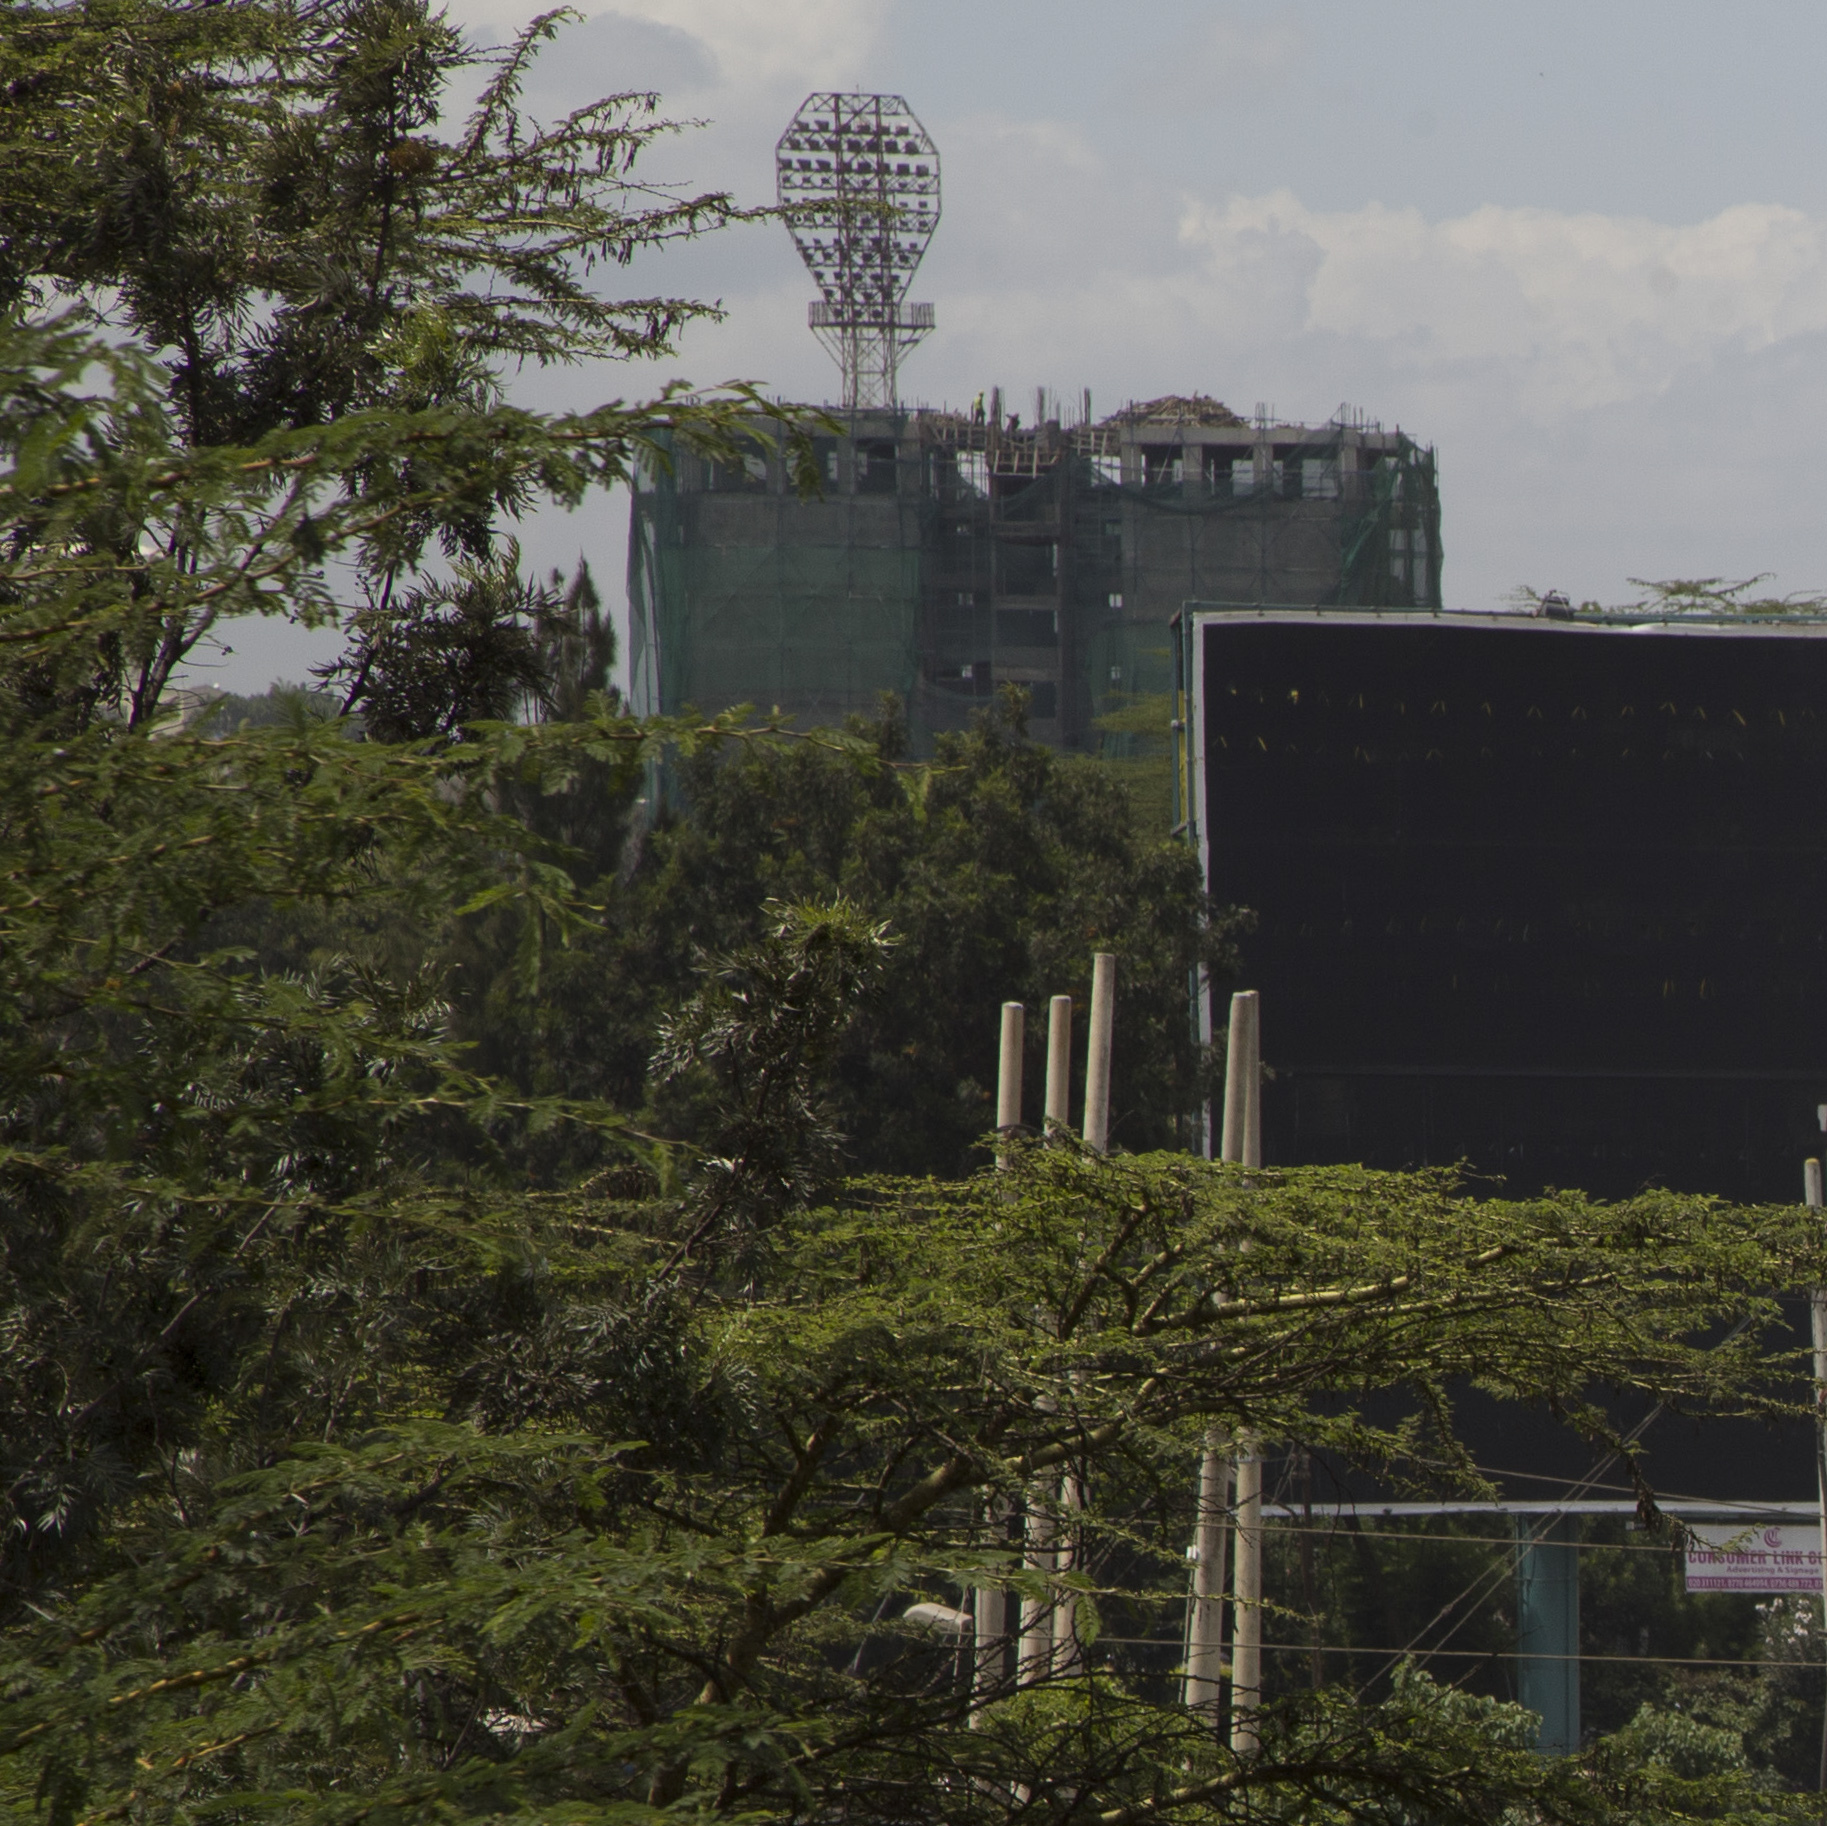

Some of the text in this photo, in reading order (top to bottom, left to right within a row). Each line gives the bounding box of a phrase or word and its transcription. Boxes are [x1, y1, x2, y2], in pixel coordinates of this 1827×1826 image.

[1688, 1550, 1767, 1566] CONSUMER
[1773, 1551, 1803, 1566] LINK
[1726, 1565, 1775, 1575] Advertising
[1784, 1566, 1819, 1575] Signage
